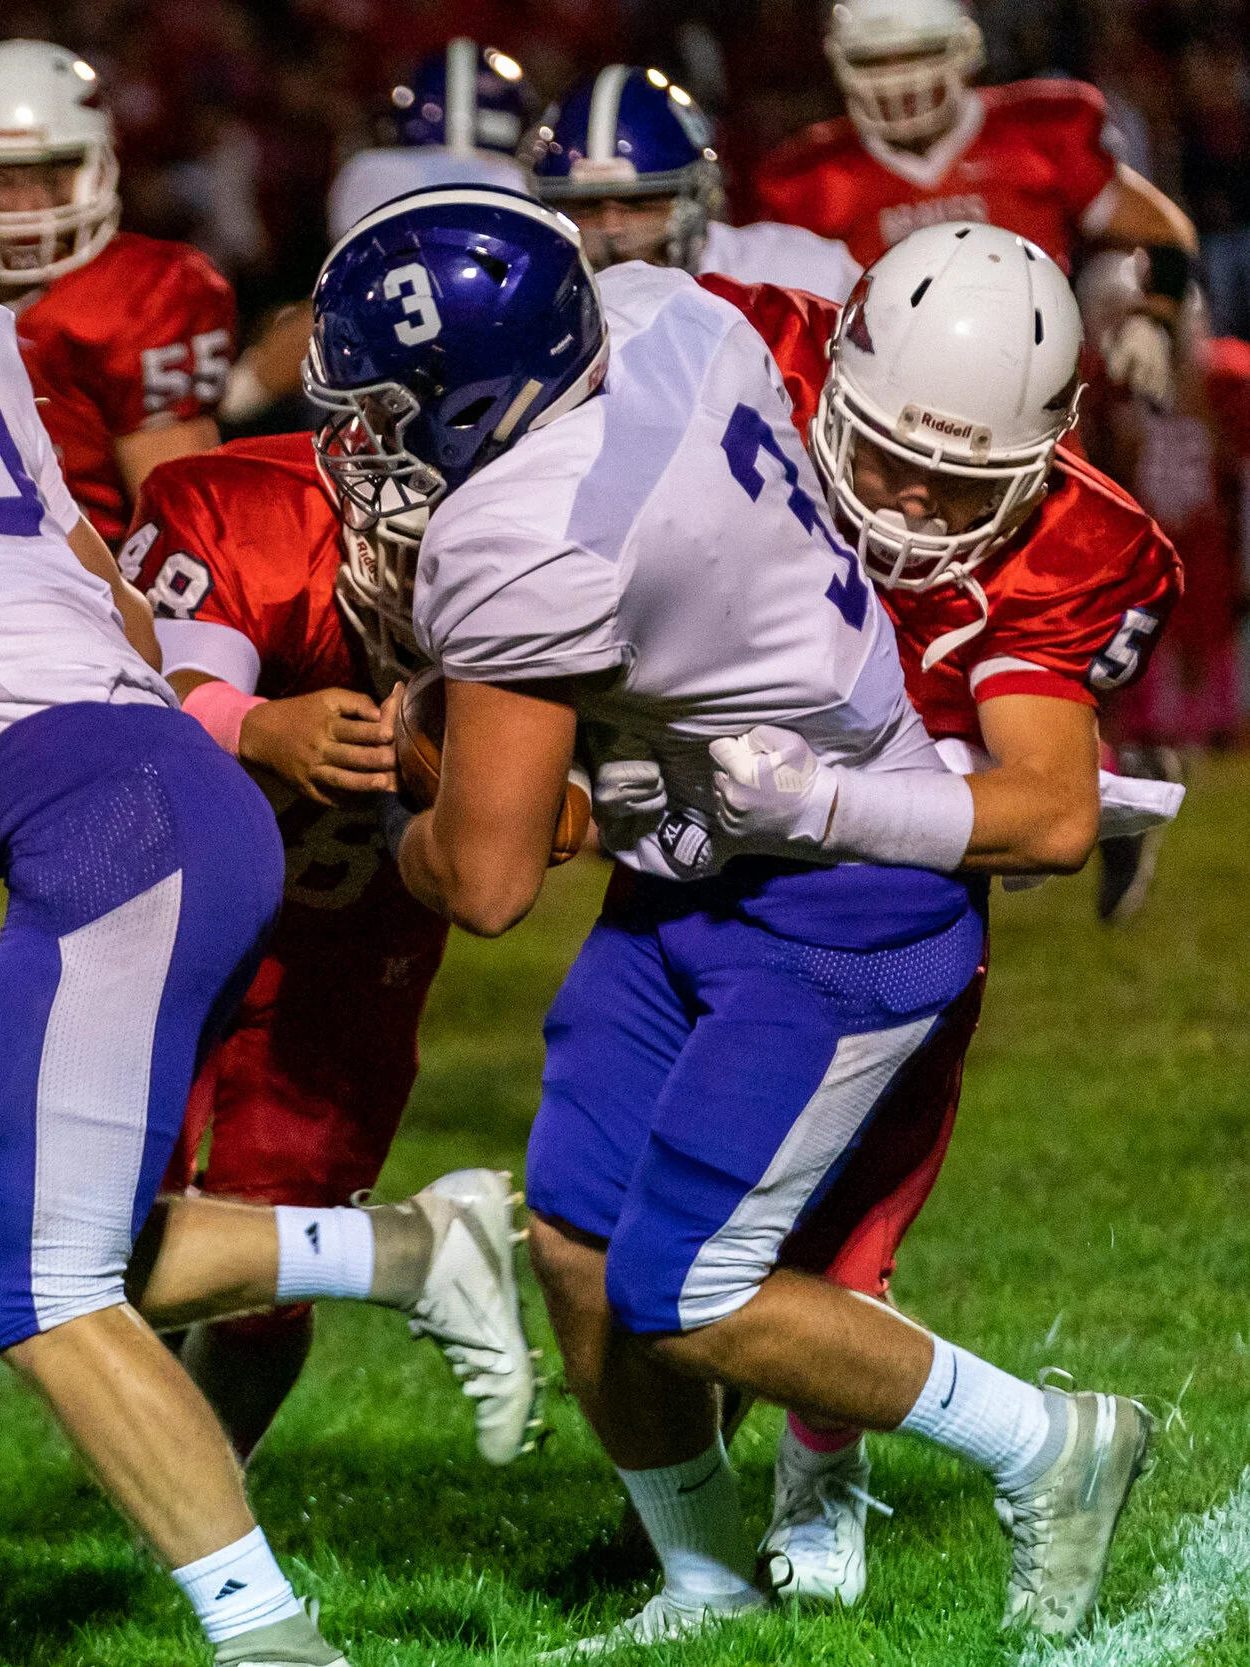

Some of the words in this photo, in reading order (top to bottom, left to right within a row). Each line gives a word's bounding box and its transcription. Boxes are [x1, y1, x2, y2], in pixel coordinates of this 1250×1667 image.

[382, 262, 442, 347] 3
[141, 328, 231, 411] 55
[920, 411, 973, 440] Riddell
[1088, 606, 1160, 690] 5
[662, 822, 684, 847] XL
